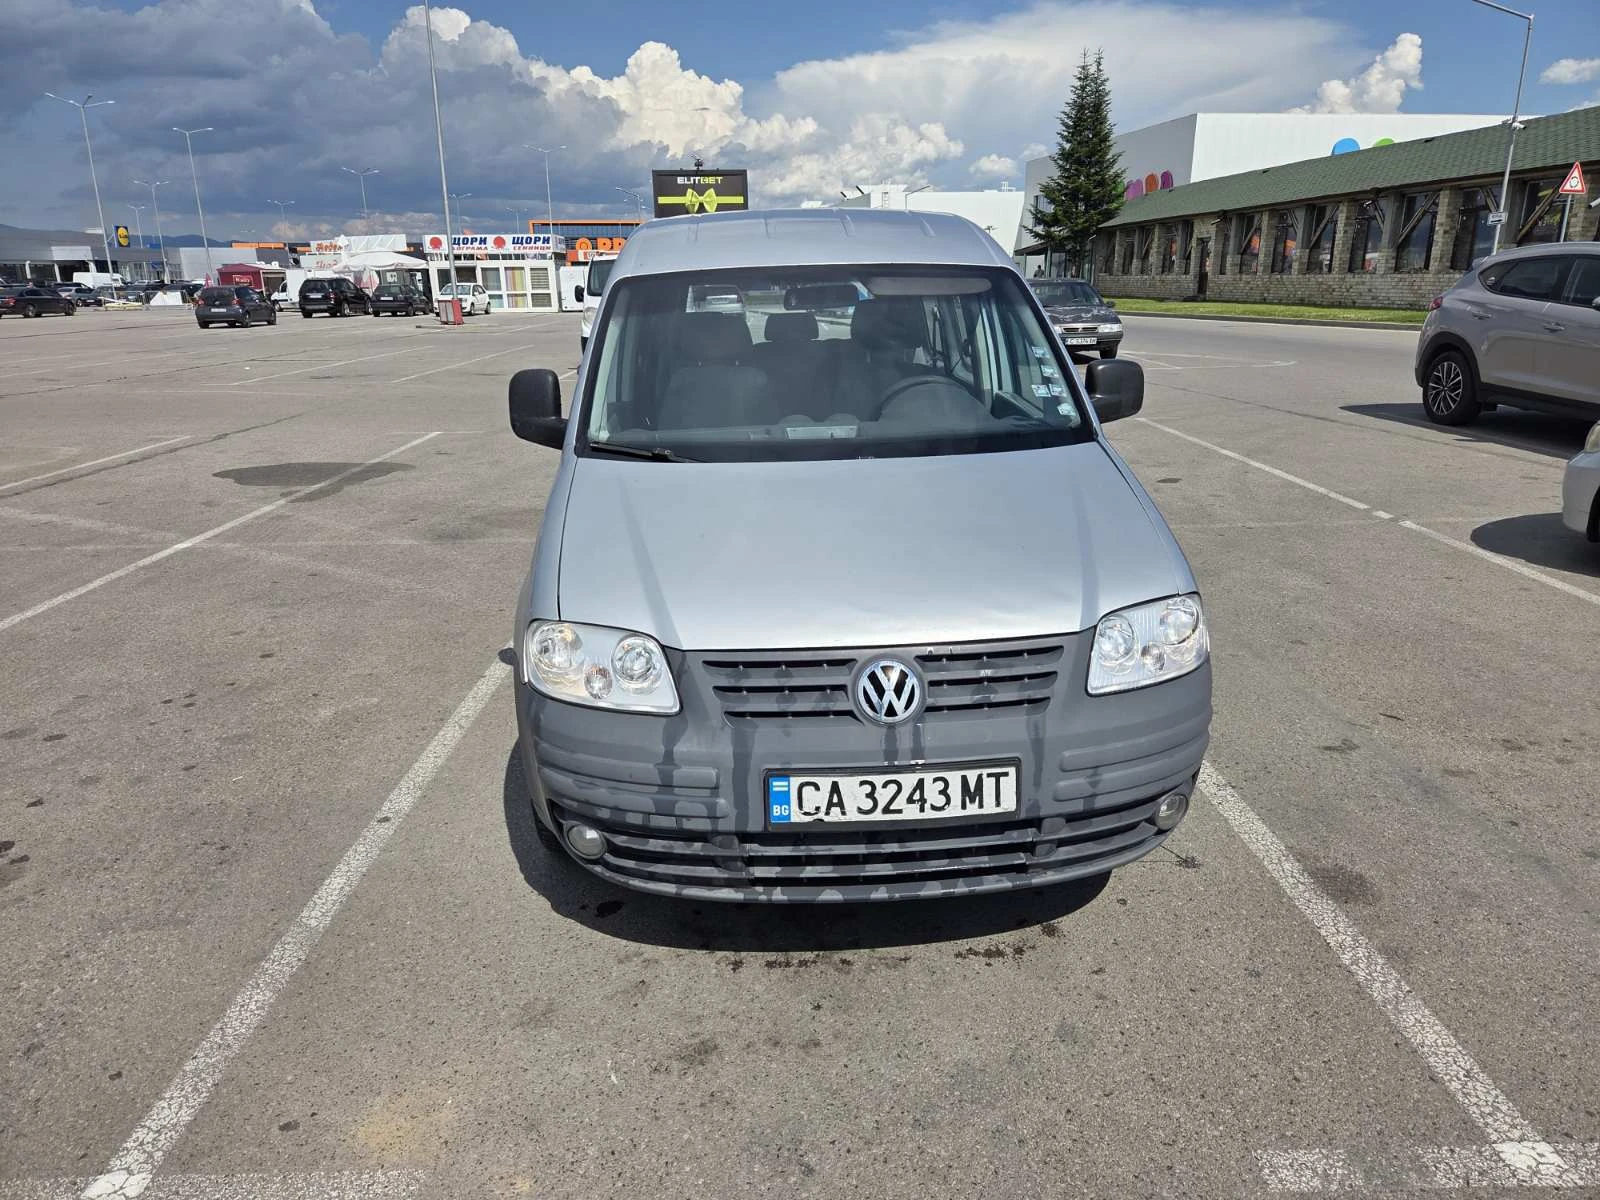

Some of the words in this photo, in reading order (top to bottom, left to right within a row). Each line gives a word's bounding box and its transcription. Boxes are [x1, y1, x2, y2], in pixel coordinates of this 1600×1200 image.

[511, 236, 551, 245] ЩОРИ
[797, 780, 847, 816] CA
[857, 776, 951, 815] 3243
[961, 772, 1009, 811] MT
[773, 805, 789, 816] BG
